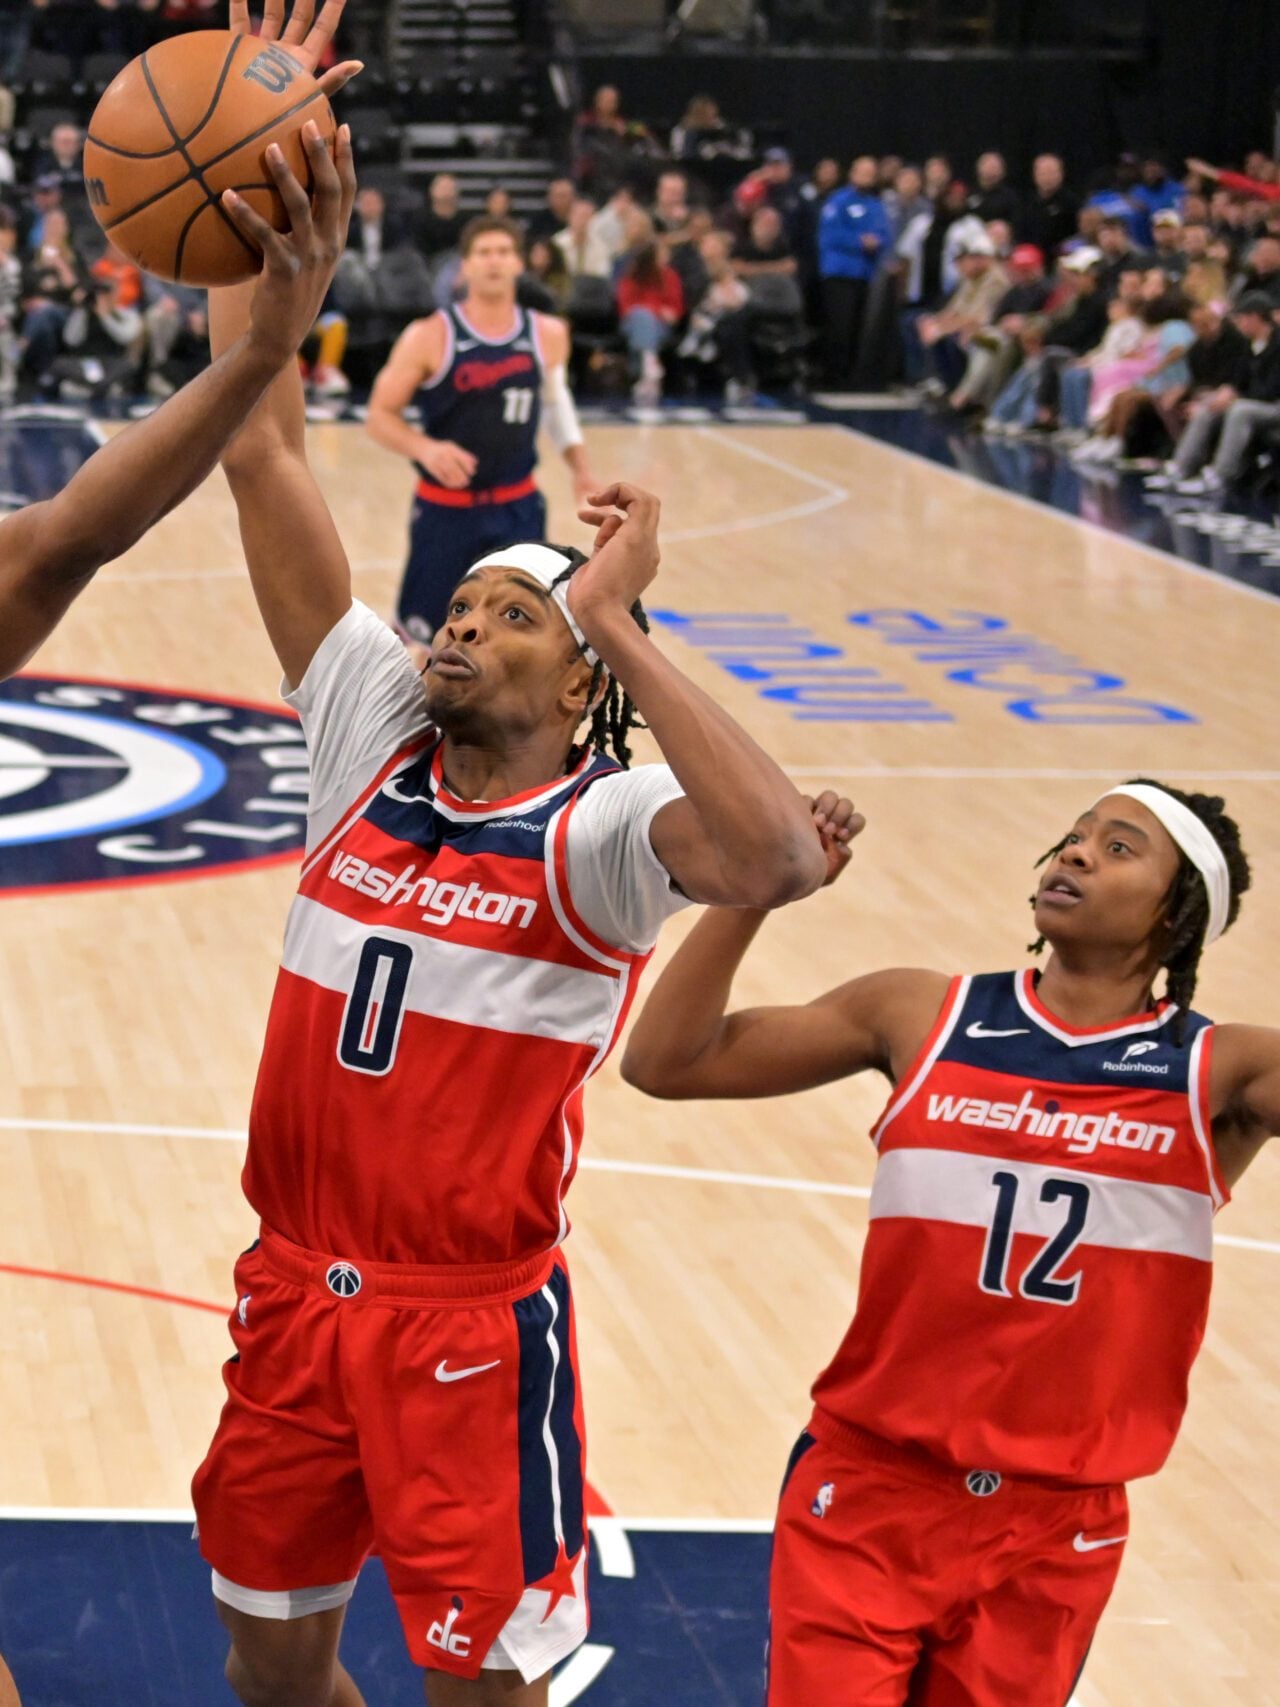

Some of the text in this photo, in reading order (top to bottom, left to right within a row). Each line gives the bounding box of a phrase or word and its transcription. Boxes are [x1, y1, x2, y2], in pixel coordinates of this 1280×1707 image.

[502, 386, 534, 424] 11
[337, 935, 413, 1076] 0
[1102, 1060, 1169, 1075] Robinhood
[926, 1089, 1176, 1155] washington
[978, 1170, 1091, 1306] 12
